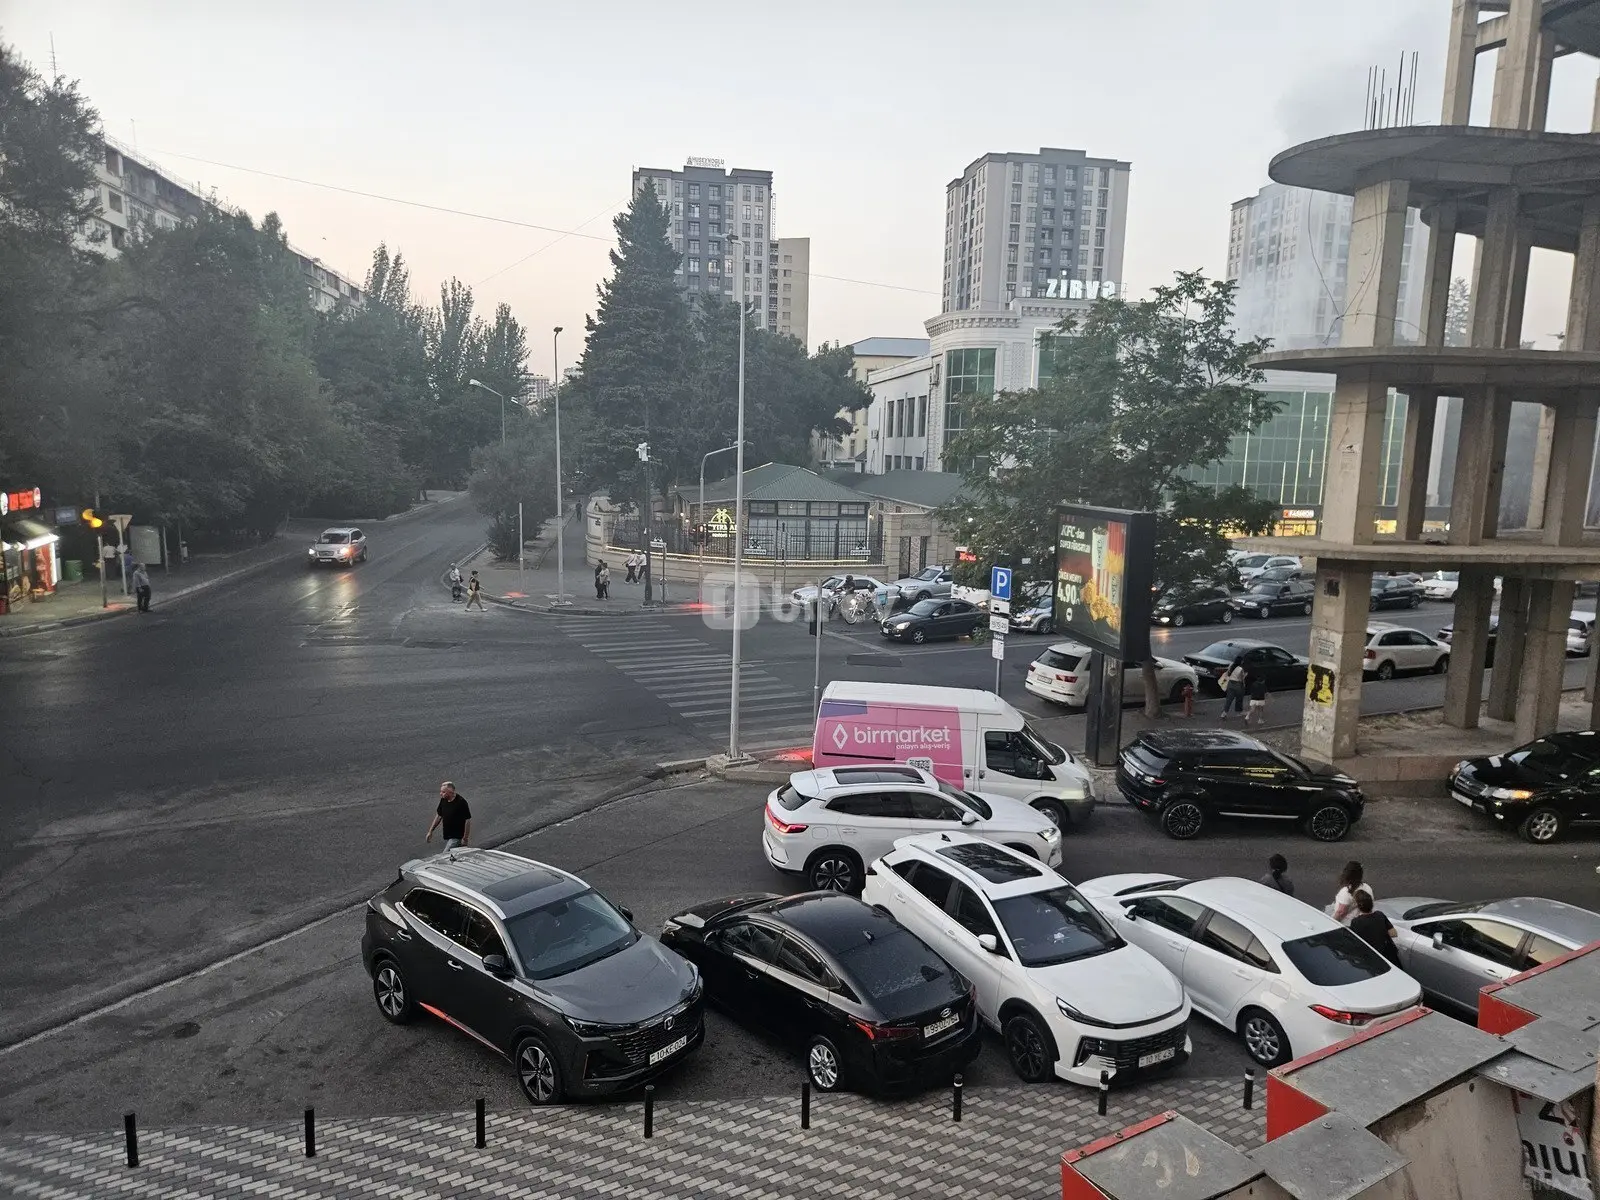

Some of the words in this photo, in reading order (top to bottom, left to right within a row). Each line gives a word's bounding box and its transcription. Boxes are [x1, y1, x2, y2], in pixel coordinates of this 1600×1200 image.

[996, 571, 1008, 594] P
[854, 725, 950, 744] birmarket
[896, 743, 919, 751] onlayn
